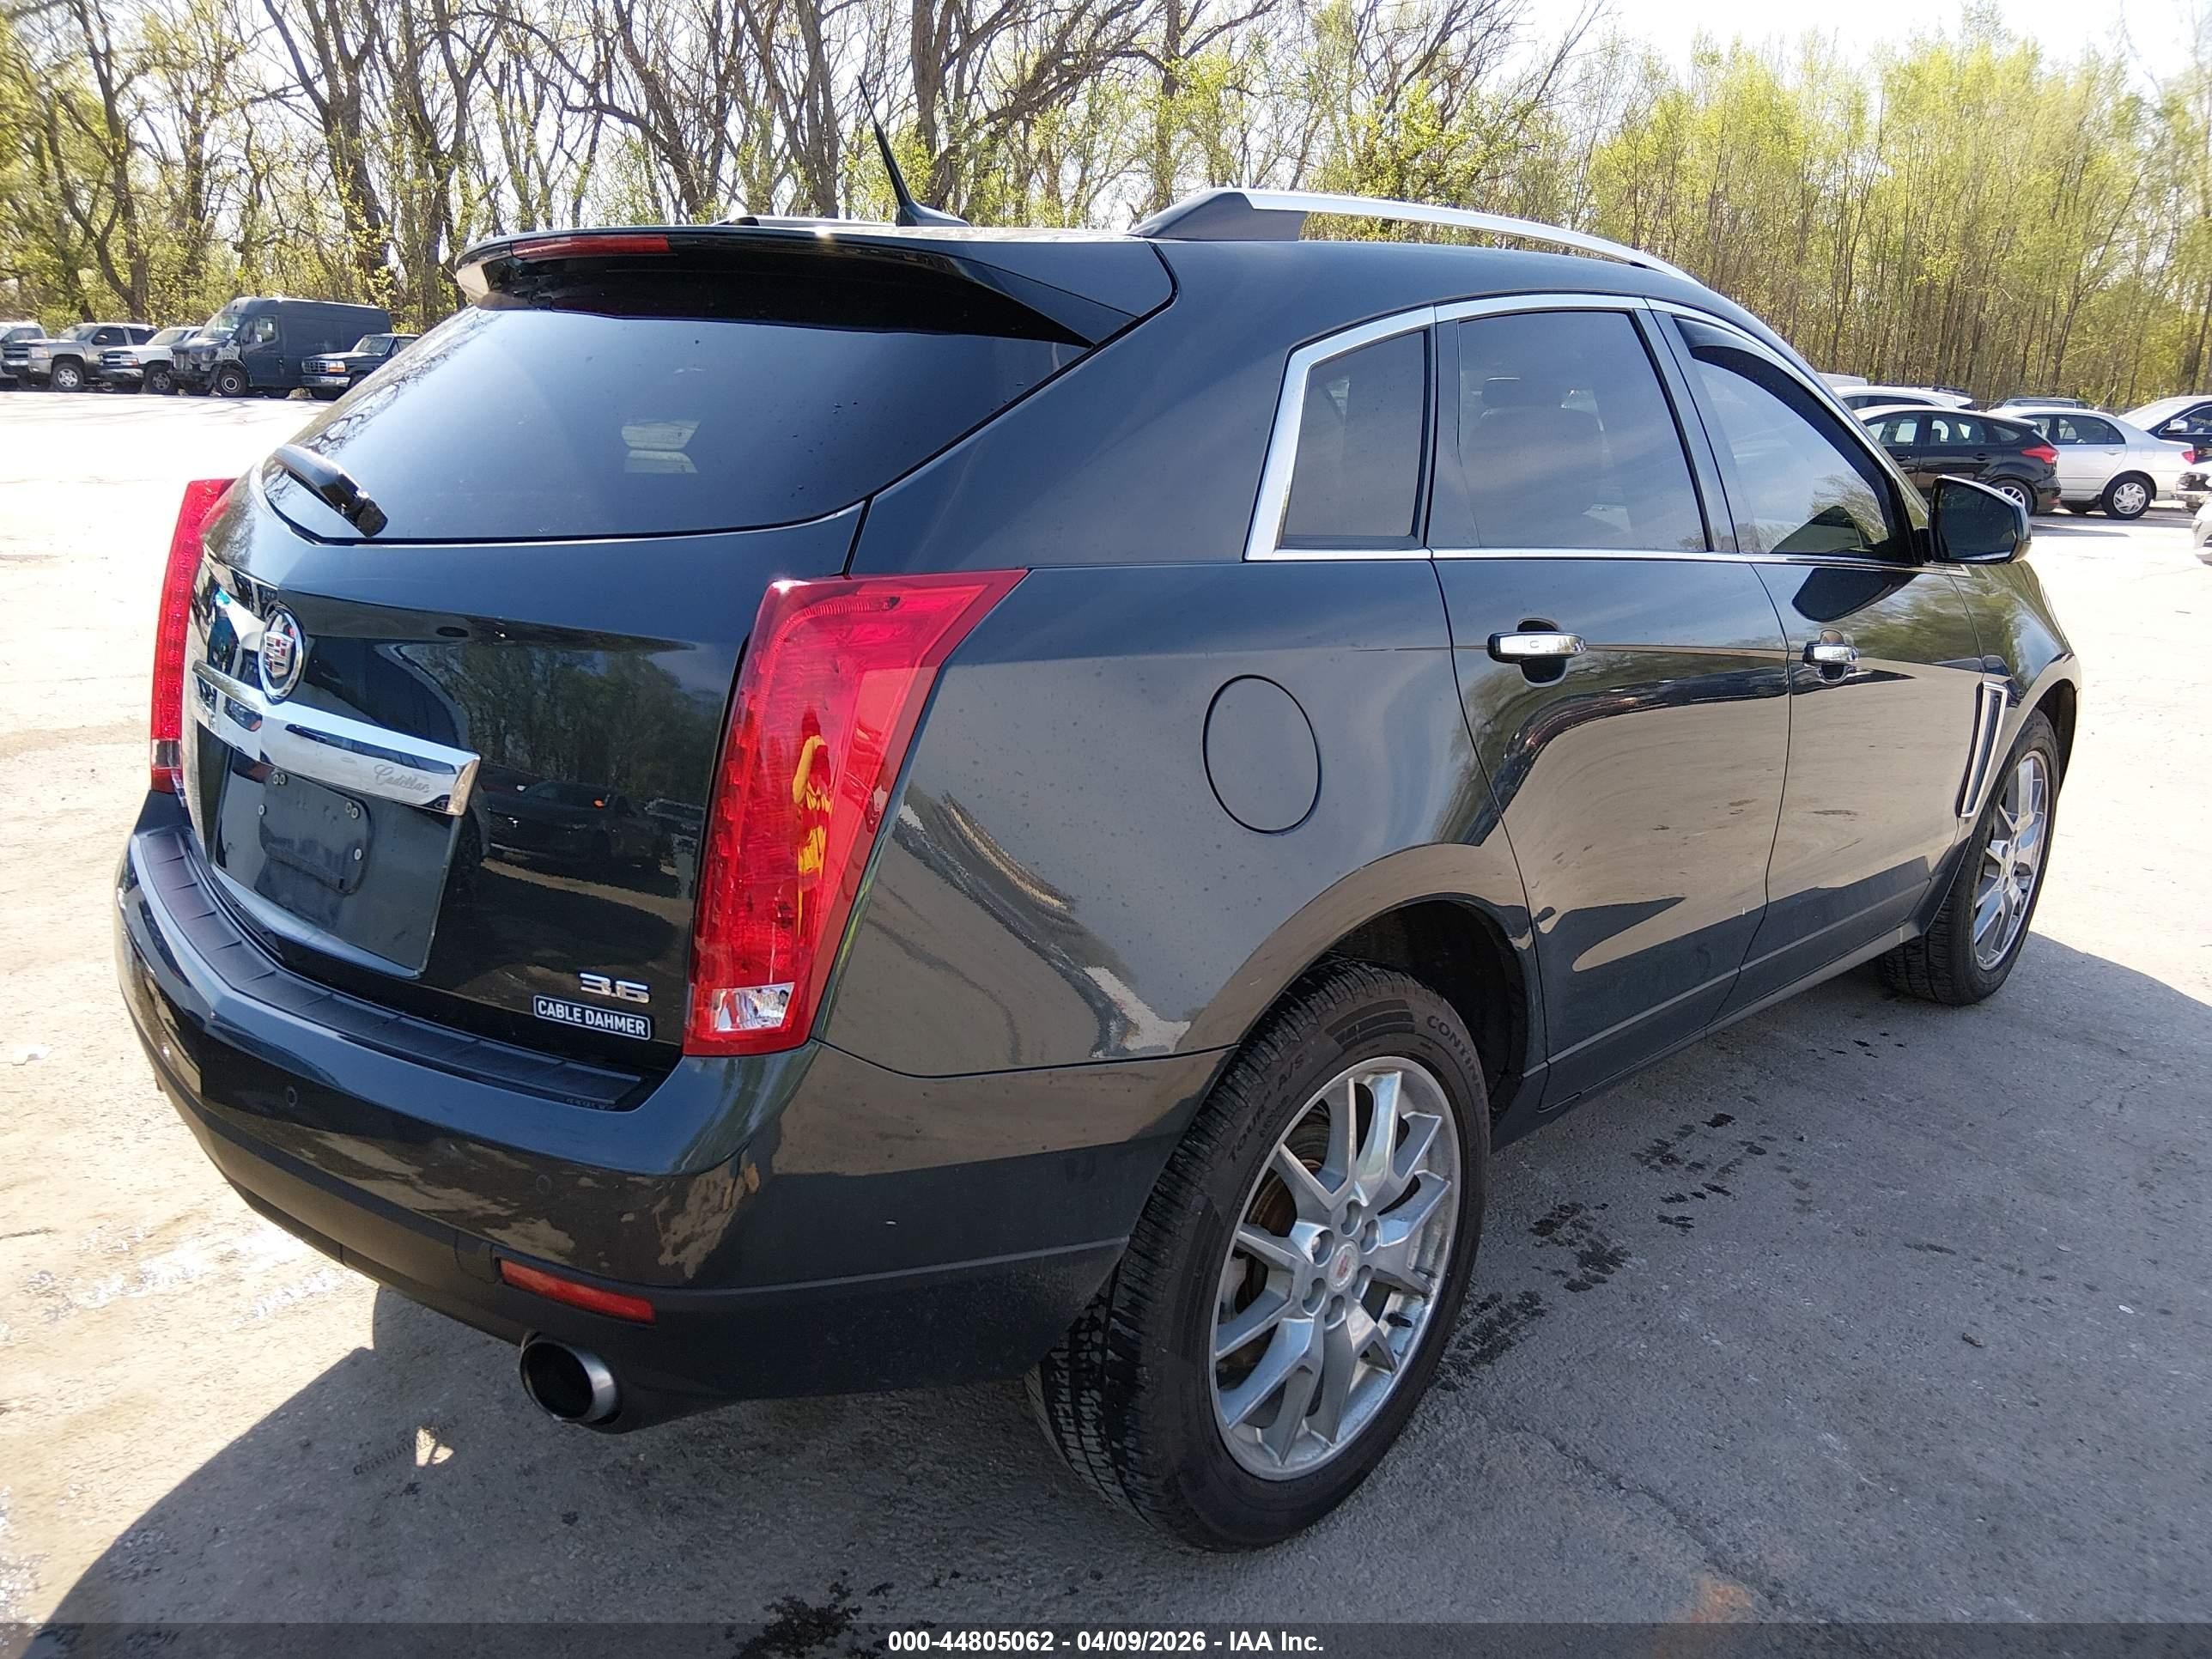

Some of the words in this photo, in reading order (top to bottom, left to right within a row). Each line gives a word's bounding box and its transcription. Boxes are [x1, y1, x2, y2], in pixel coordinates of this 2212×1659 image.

[374, 763, 430, 793] Cadillac
[579, 972, 651, 1004] 3.6
[537, 1000, 583, 1024] CABLE
[585, 1009, 647, 1036] DAHMER
